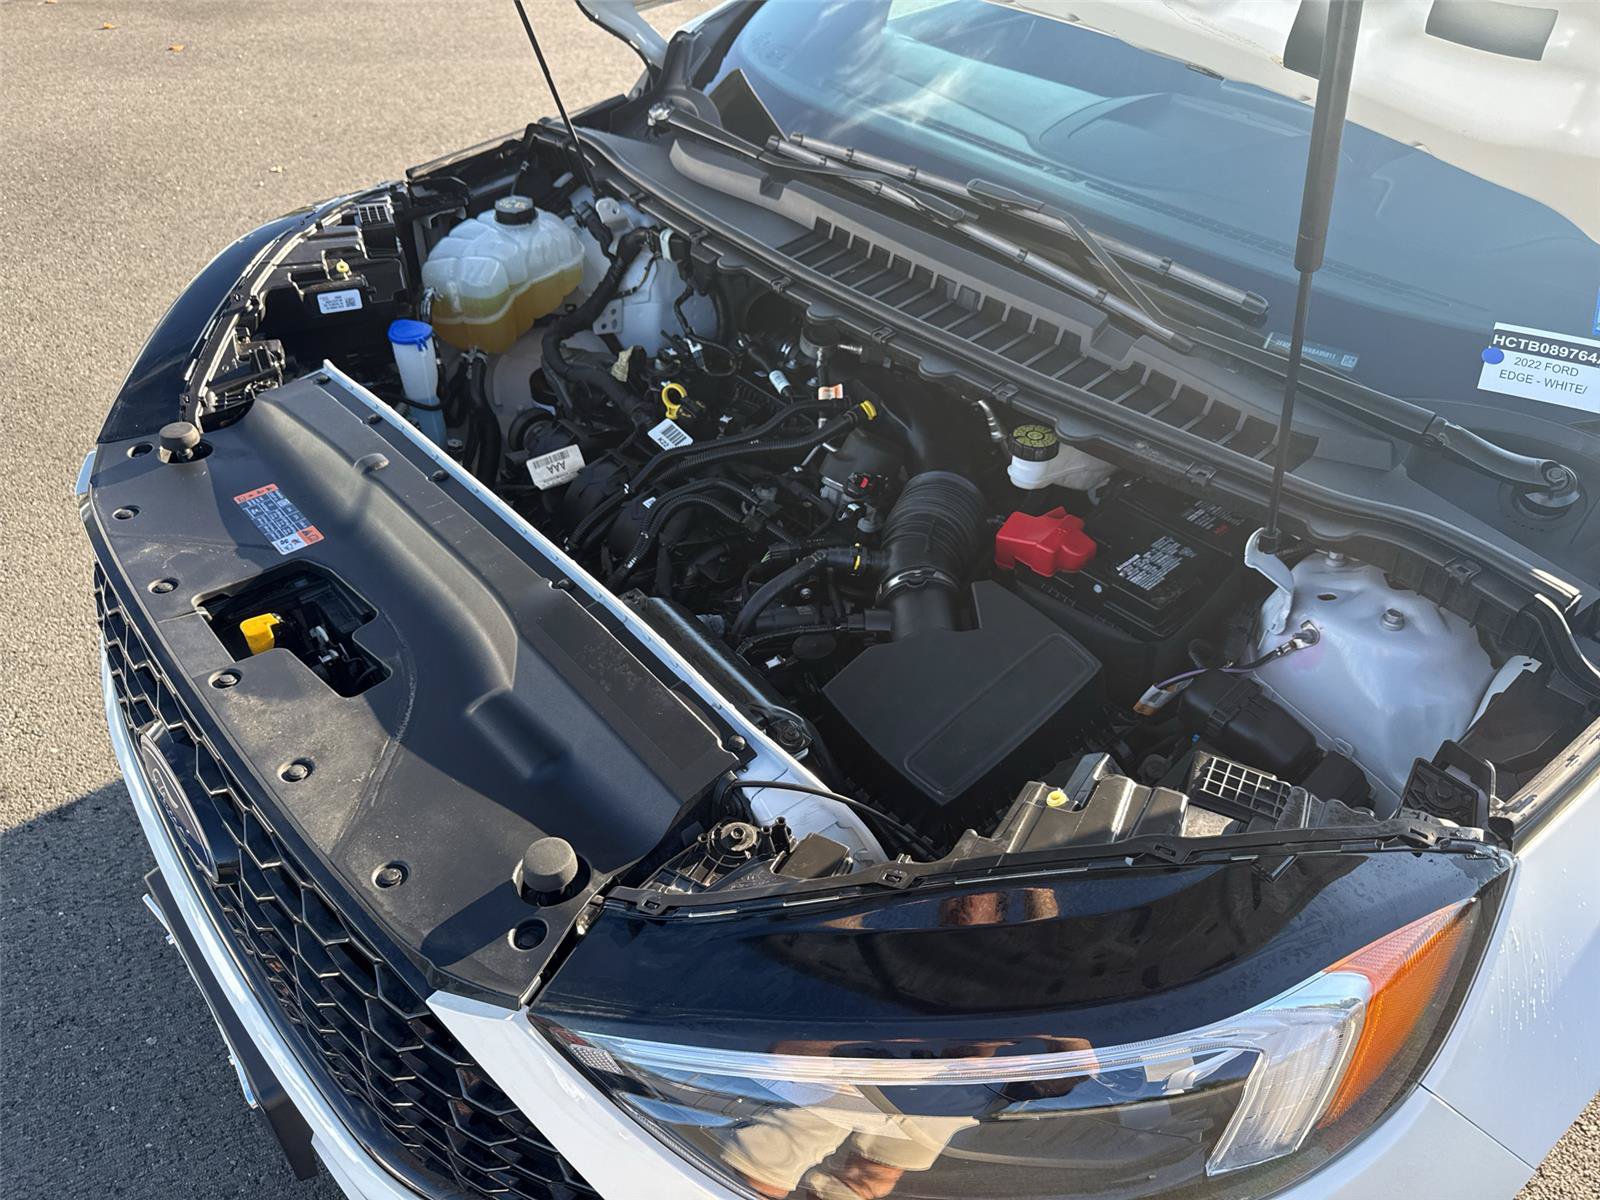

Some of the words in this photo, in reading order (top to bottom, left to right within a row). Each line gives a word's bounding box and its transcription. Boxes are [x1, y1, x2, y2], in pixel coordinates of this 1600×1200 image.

[1514, 357, 1541, 370] 2022
[1544, 362, 1579, 377] FORD
[1499, 369, 1534, 384] EDGE
[1544, 377, 1588, 395] WHITE/
[546, 460, 566, 474] AAA
